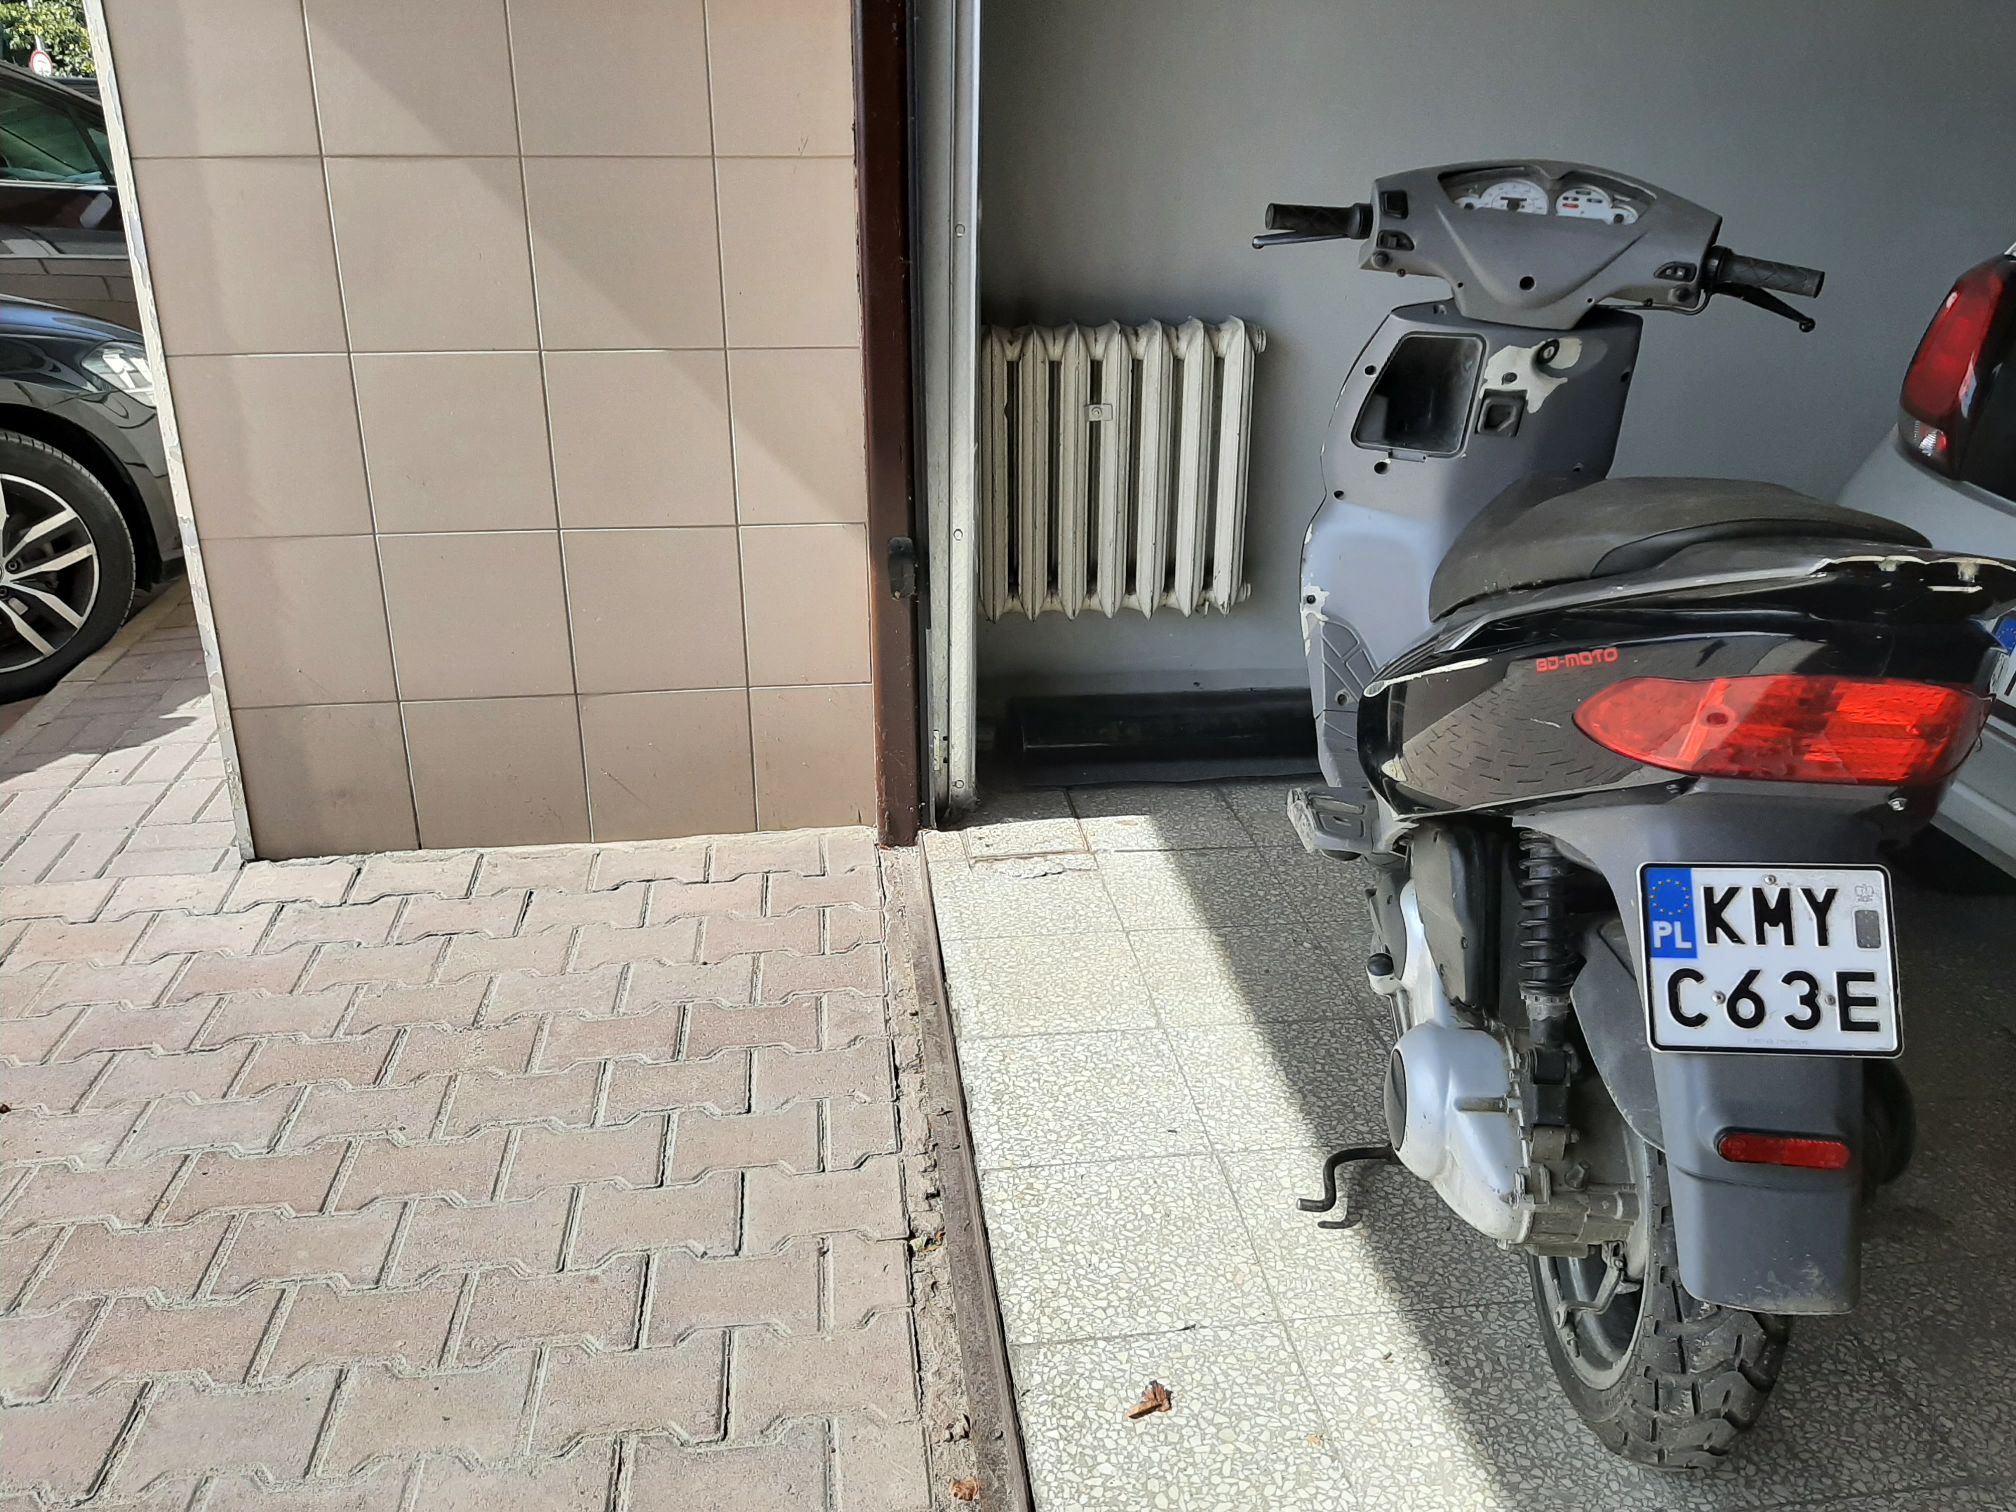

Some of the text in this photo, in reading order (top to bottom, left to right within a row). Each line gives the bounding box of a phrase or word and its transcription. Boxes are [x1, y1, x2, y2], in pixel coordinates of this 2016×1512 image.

[1652, 920, 1693, 949] PL
[1702, 886, 1839, 947] KMY
[1667, 967, 1881, 1033] C63E
